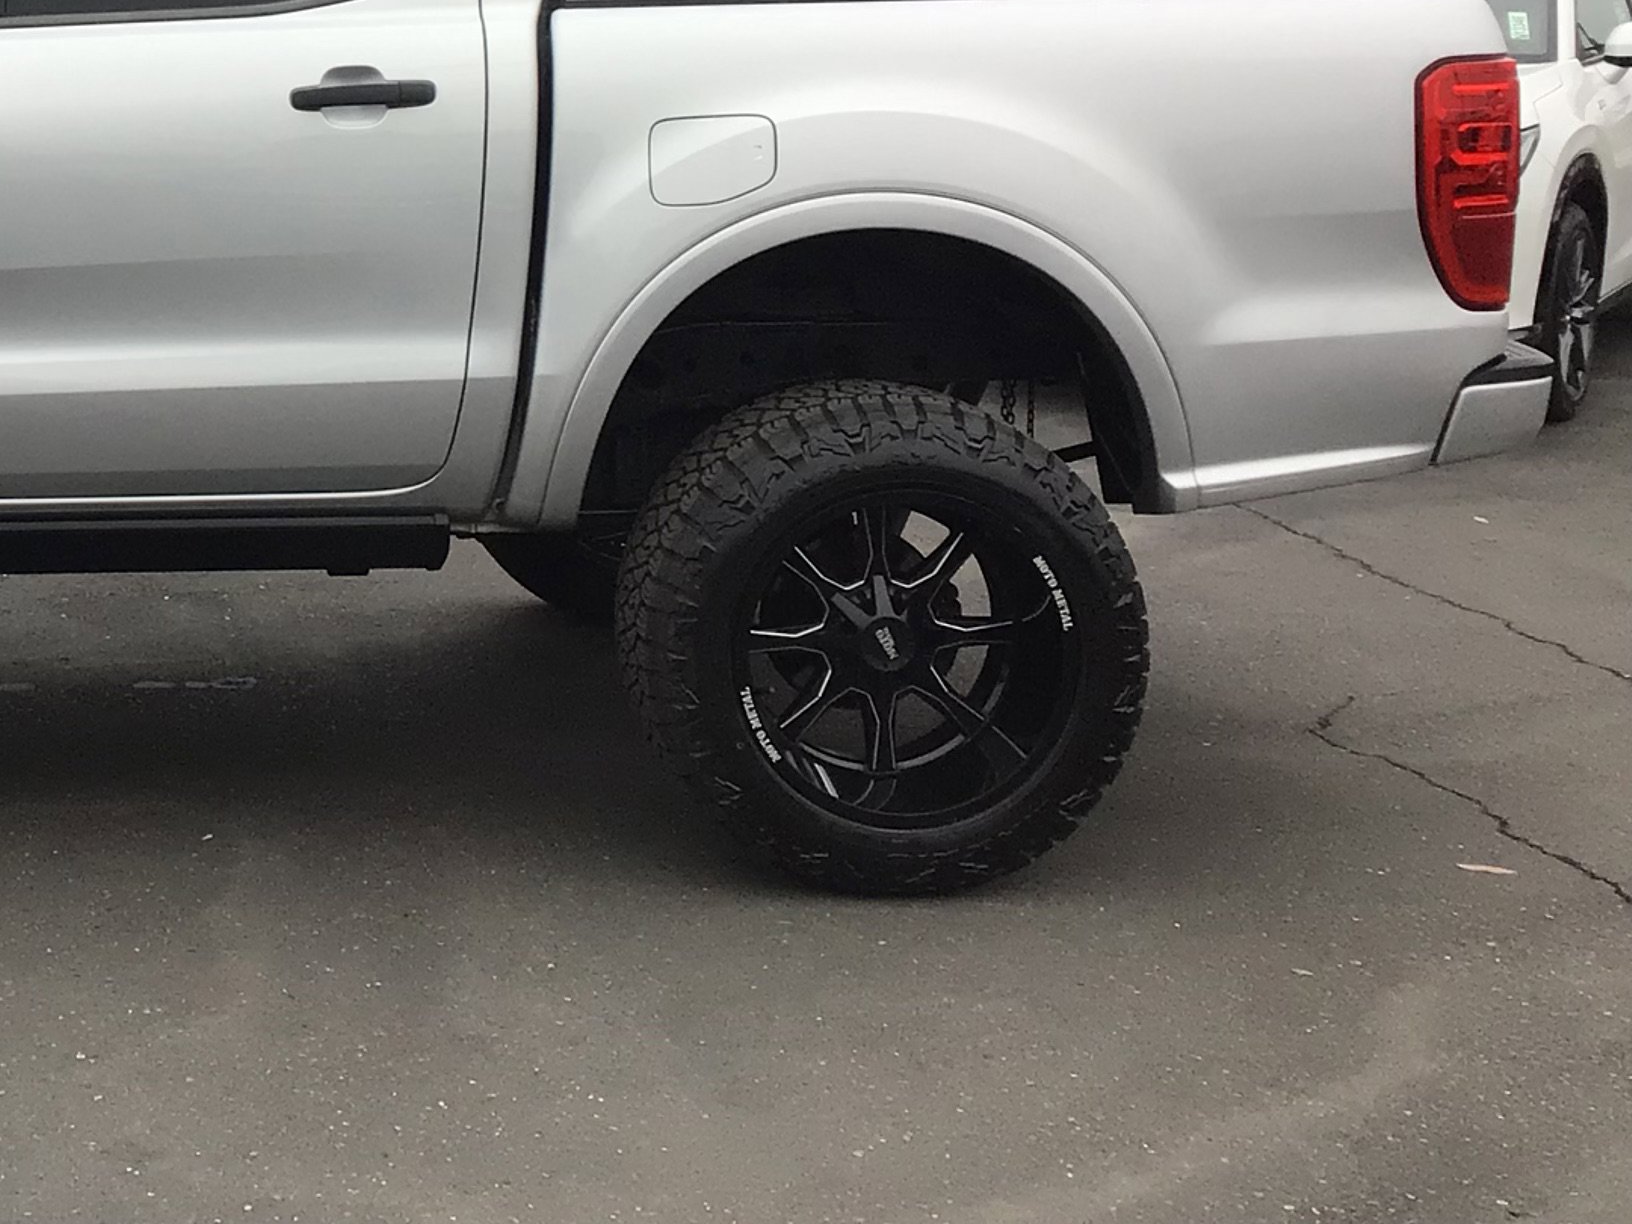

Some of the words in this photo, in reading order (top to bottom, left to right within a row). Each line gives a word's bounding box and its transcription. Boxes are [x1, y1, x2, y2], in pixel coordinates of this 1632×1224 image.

[1032, 555, 1058, 588] MOTO
[1051, 588, 1074, 632] METAL
[740, 686, 762, 730] METAL
[756, 730, 782, 763] MOTO
